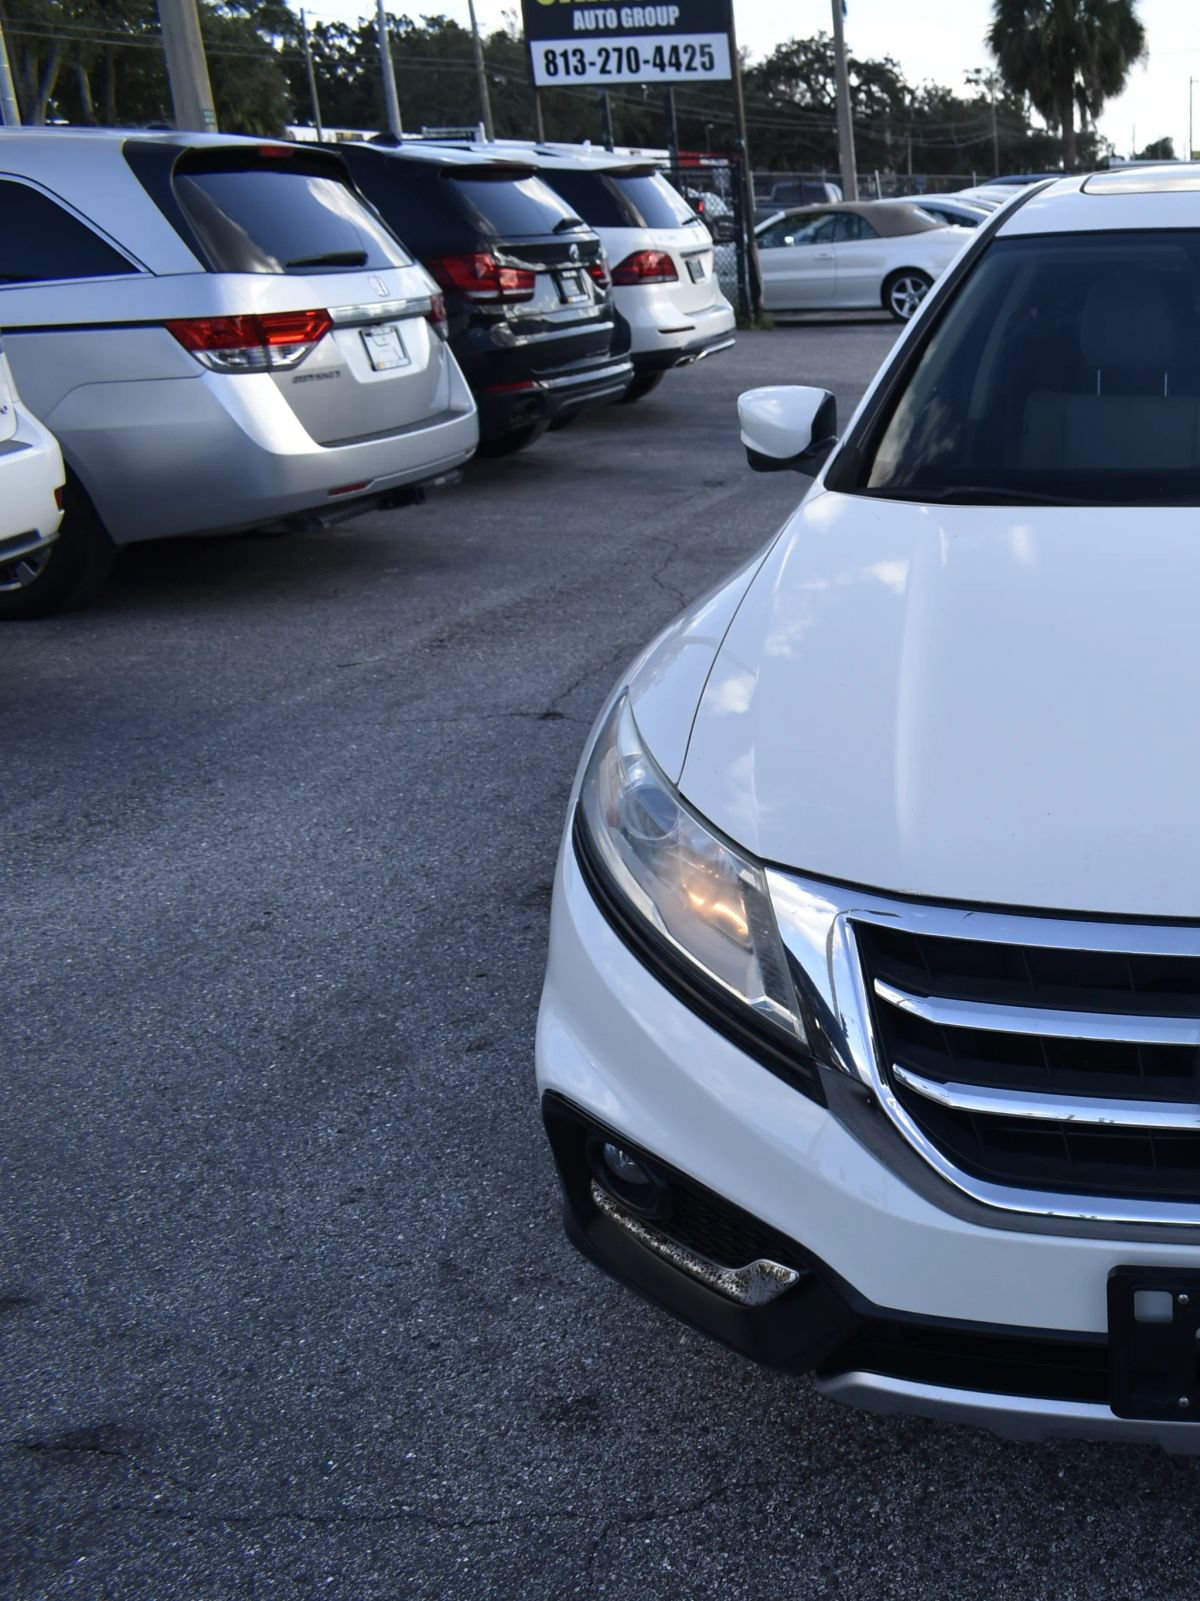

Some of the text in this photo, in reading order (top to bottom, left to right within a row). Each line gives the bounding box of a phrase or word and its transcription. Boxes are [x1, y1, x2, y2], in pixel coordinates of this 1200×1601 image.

[573, 6, 680, 30] AUTO GROUP
[544, 44, 715, 76] 813-270-4425
